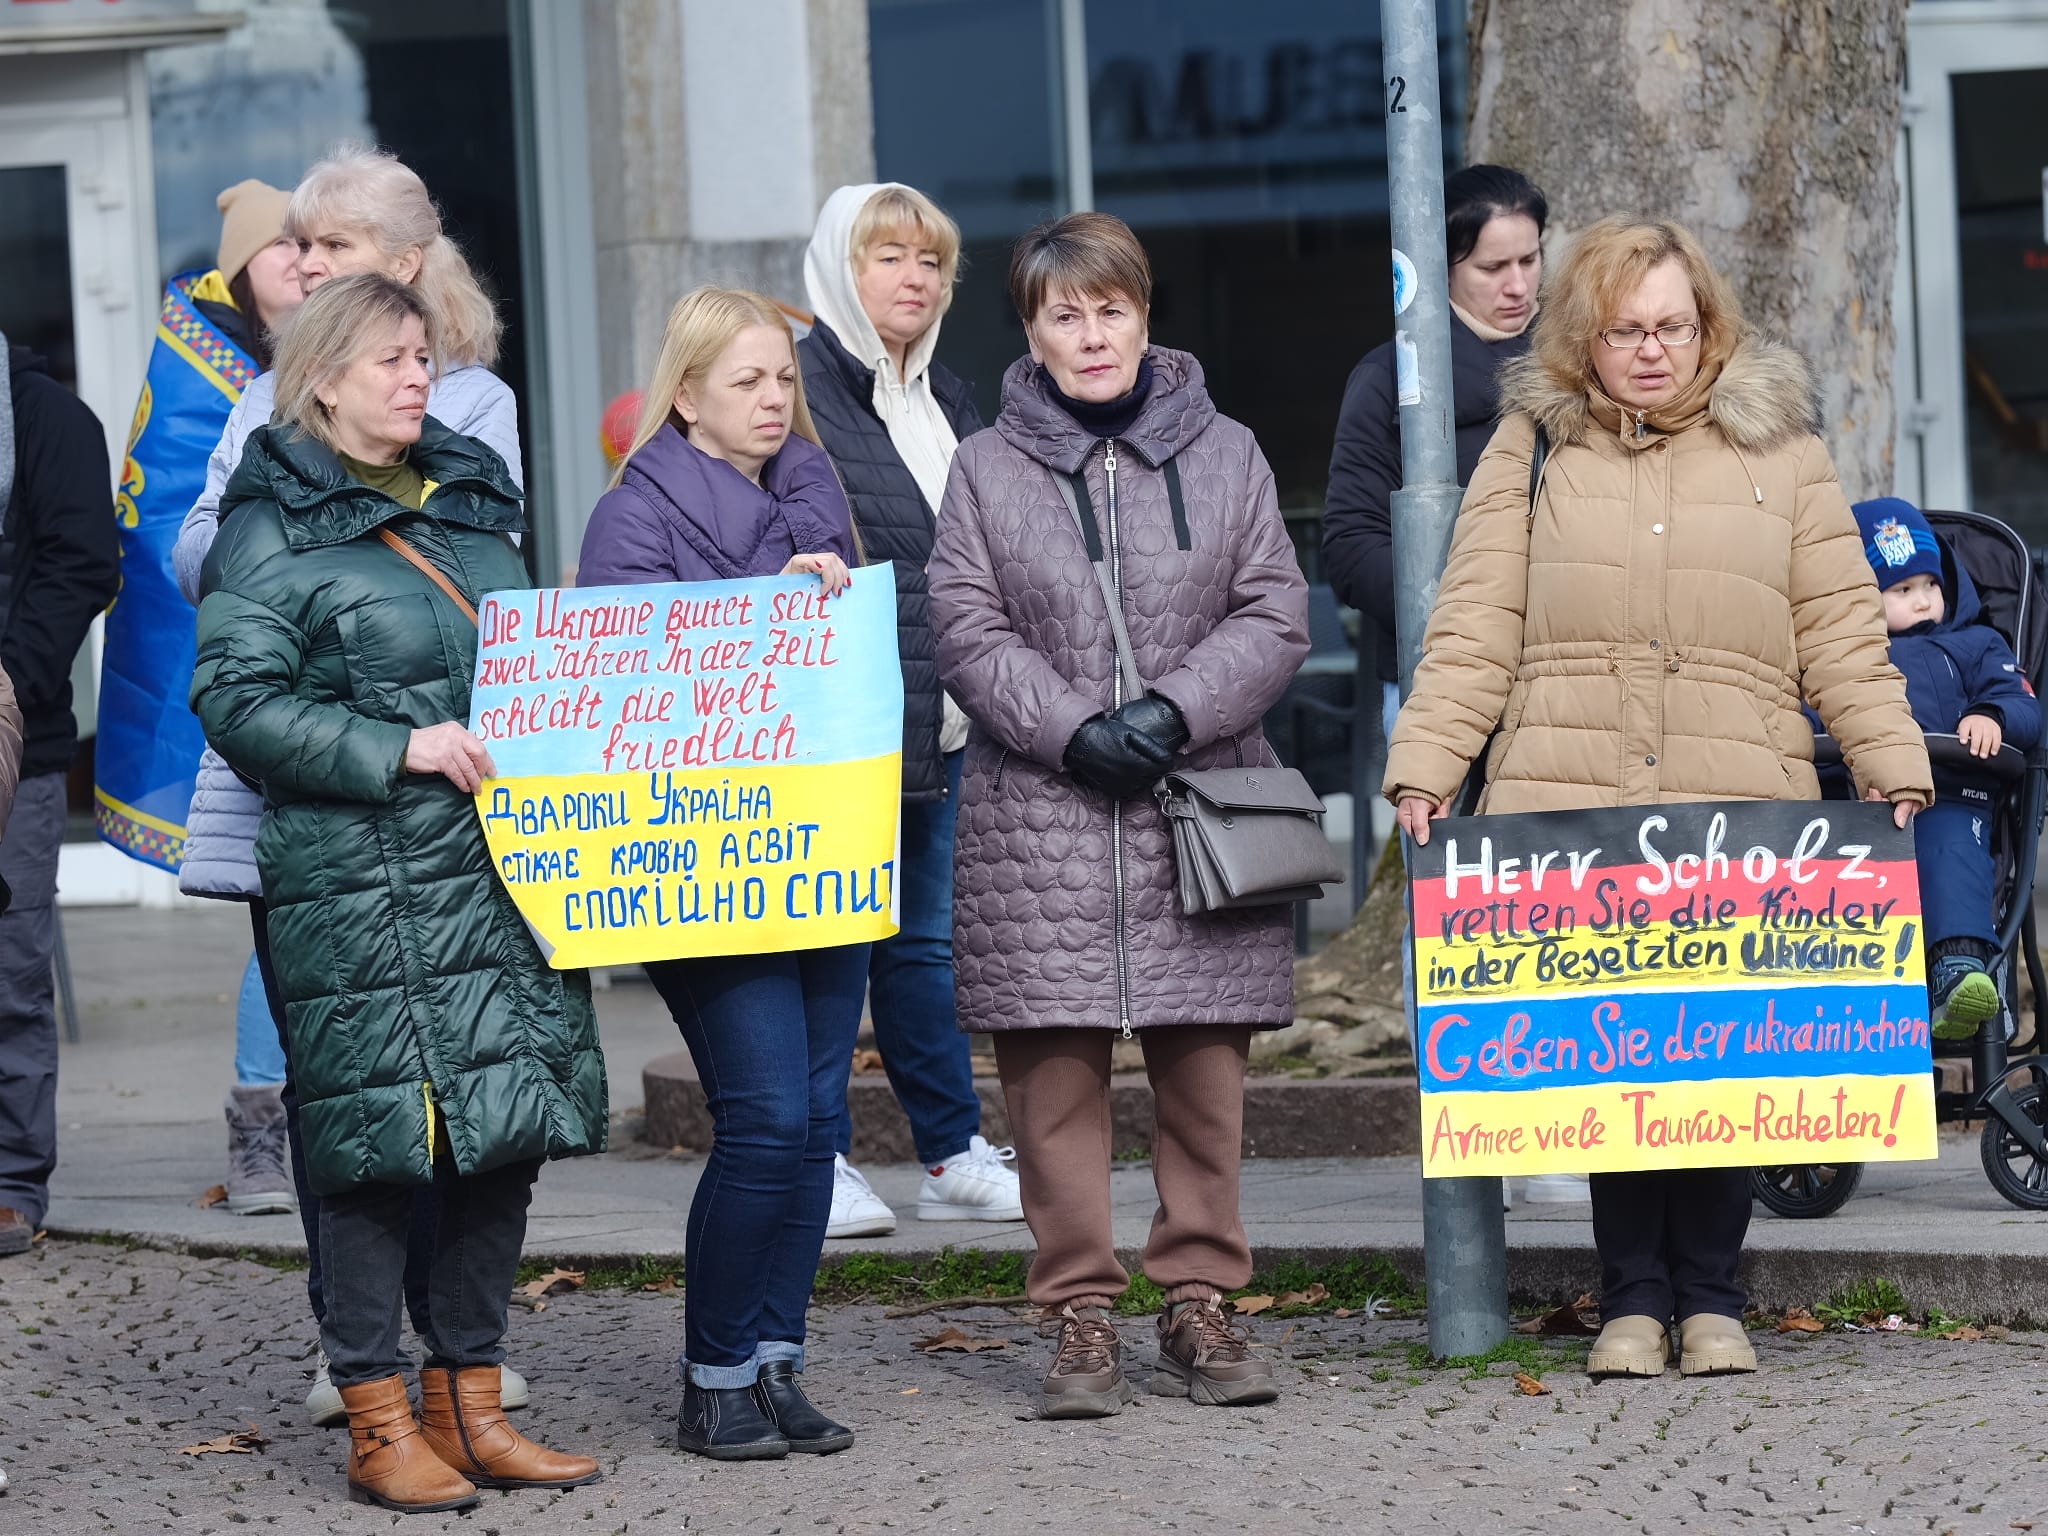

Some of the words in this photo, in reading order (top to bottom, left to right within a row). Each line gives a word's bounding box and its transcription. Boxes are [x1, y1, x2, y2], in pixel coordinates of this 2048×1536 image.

[1885, 541, 1916, 568] PAW
[483, 600, 522, 649] Die
[535, 589, 654, 640] Ukraine
[478, 649, 540, 688] zwei
[546, 640, 649, 680] Jahren
[700, 639, 754, 672] der
[761, 626, 839, 667] Zeit
[475, 683, 603, 741] schläft
[622, 686, 675, 724] die
[693, 671, 778, 717] Welt
[1440, 898, 1576, 947] retten
[1588, 878, 1652, 933] Sie
[1670, 890, 1737, 932] die
[1757, 884, 1899, 931] Kinder
[1428, 955, 1456, 990] in
[1460, 947, 1526, 989] der
[1425, 1013, 1579, 1082] Geben
[1588, 1001, 1653, 1073] Sie
[1663, 1000, 1740, 1062] der
[1743, 998, 1928, 1055] ukrainischen
[1429, 1105, 1529, 1164] Armee
[1534, 1107, 1606, 1150] viele
